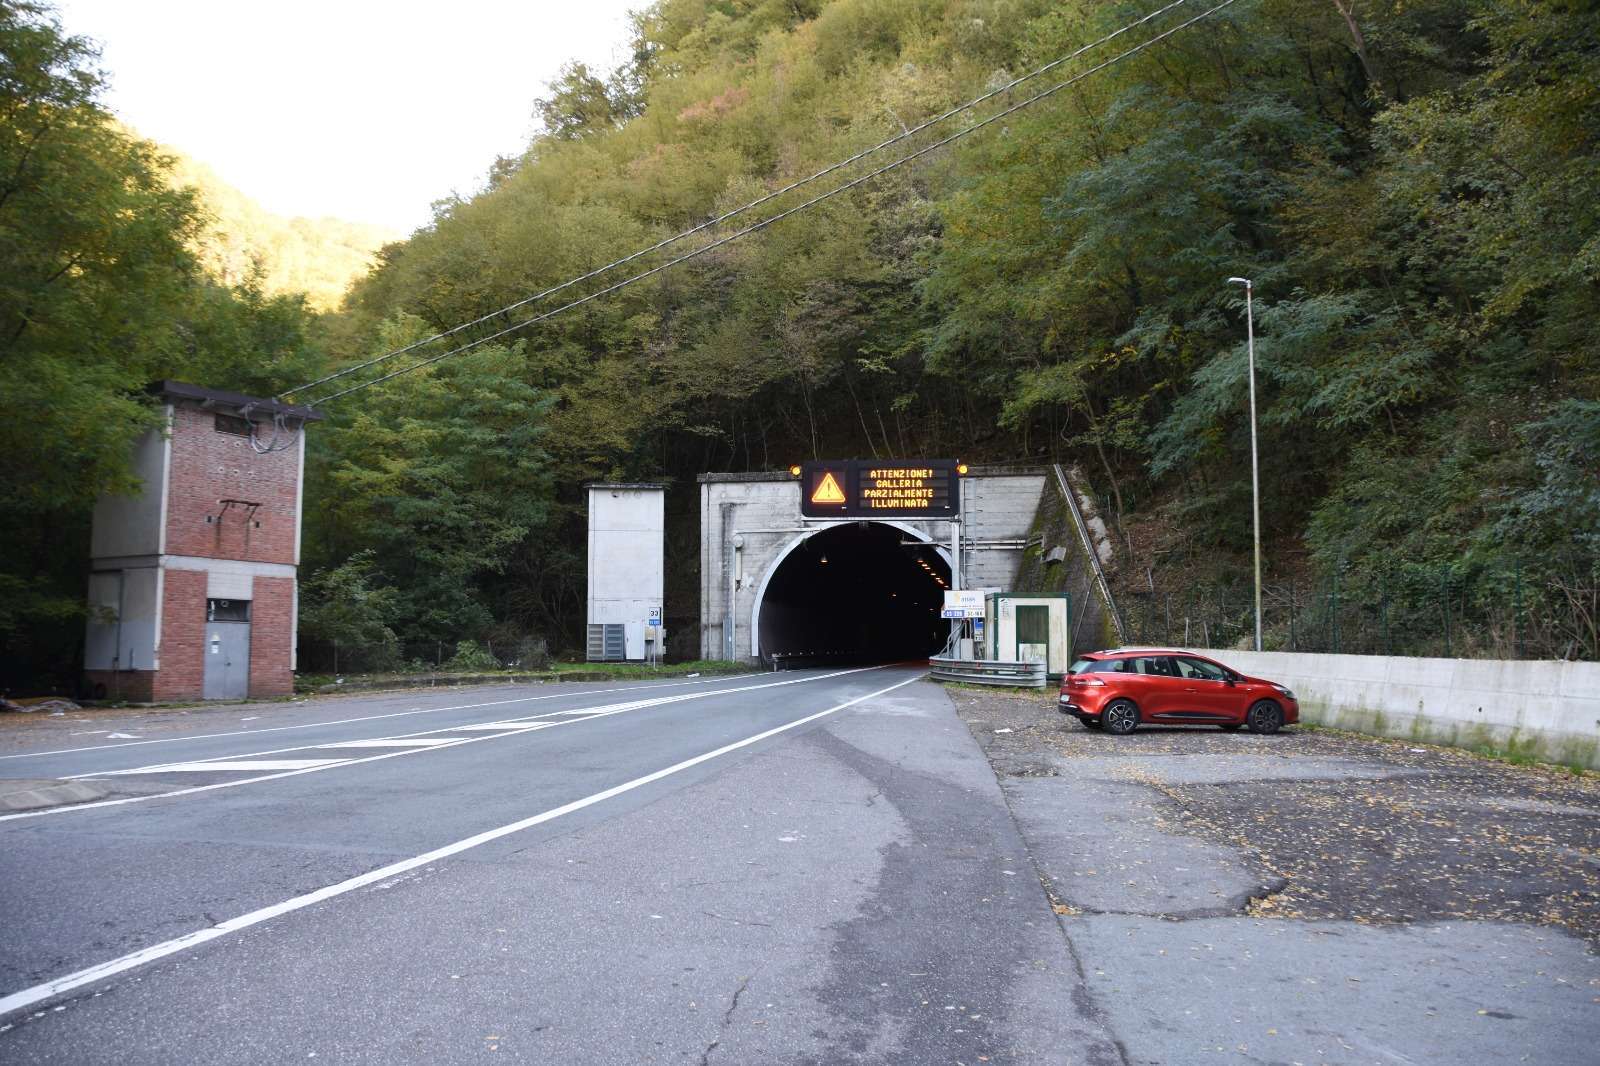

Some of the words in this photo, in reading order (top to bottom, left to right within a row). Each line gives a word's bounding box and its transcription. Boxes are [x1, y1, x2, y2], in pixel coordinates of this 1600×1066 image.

[870, 470, 933, 478] ATTENZIONE!
[876, 479, 923, 488] GALLERIA
[864, 489, 933, 498] PARZIALMENTE
[871, 499, 928, 508] ILLUMINATA
